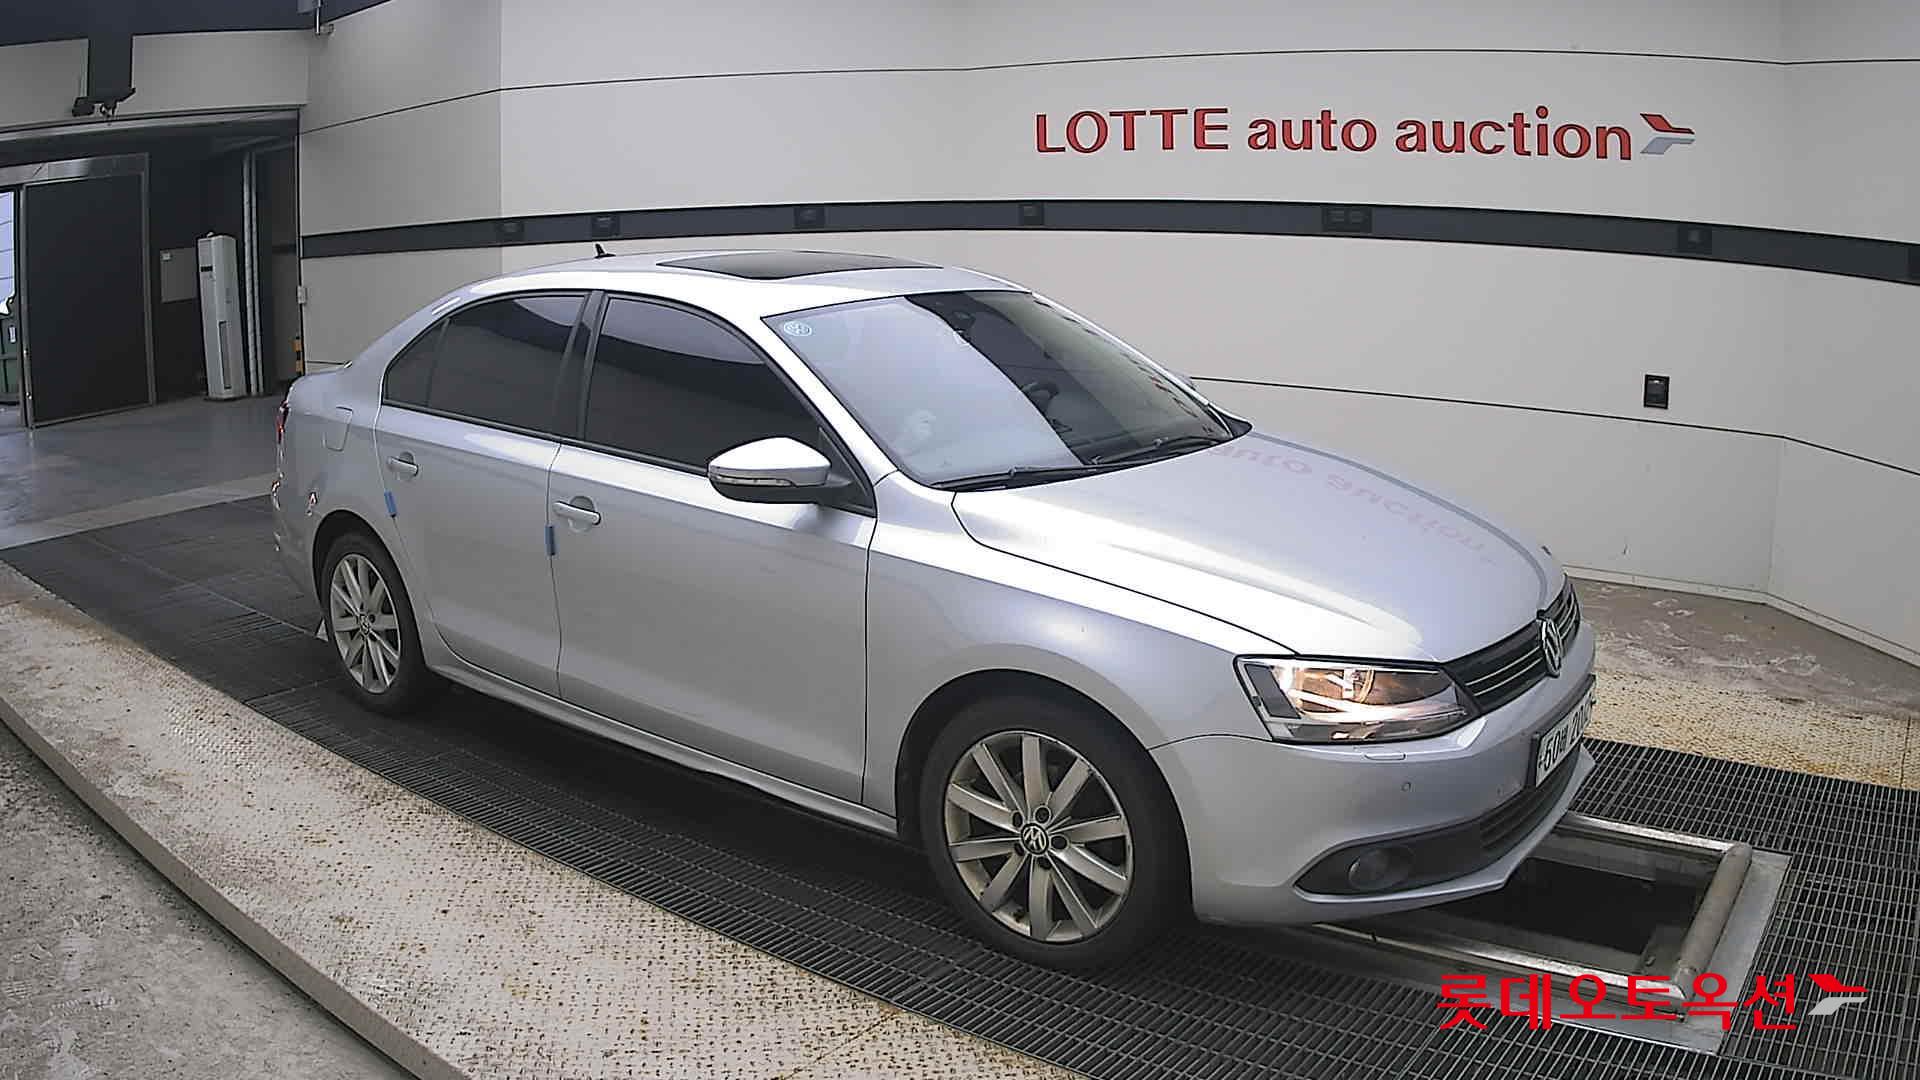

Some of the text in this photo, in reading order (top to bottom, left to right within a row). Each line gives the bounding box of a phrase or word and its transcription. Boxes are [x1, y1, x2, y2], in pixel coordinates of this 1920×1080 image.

[1036, 105, 1632, 160] LOTTE auto auction
